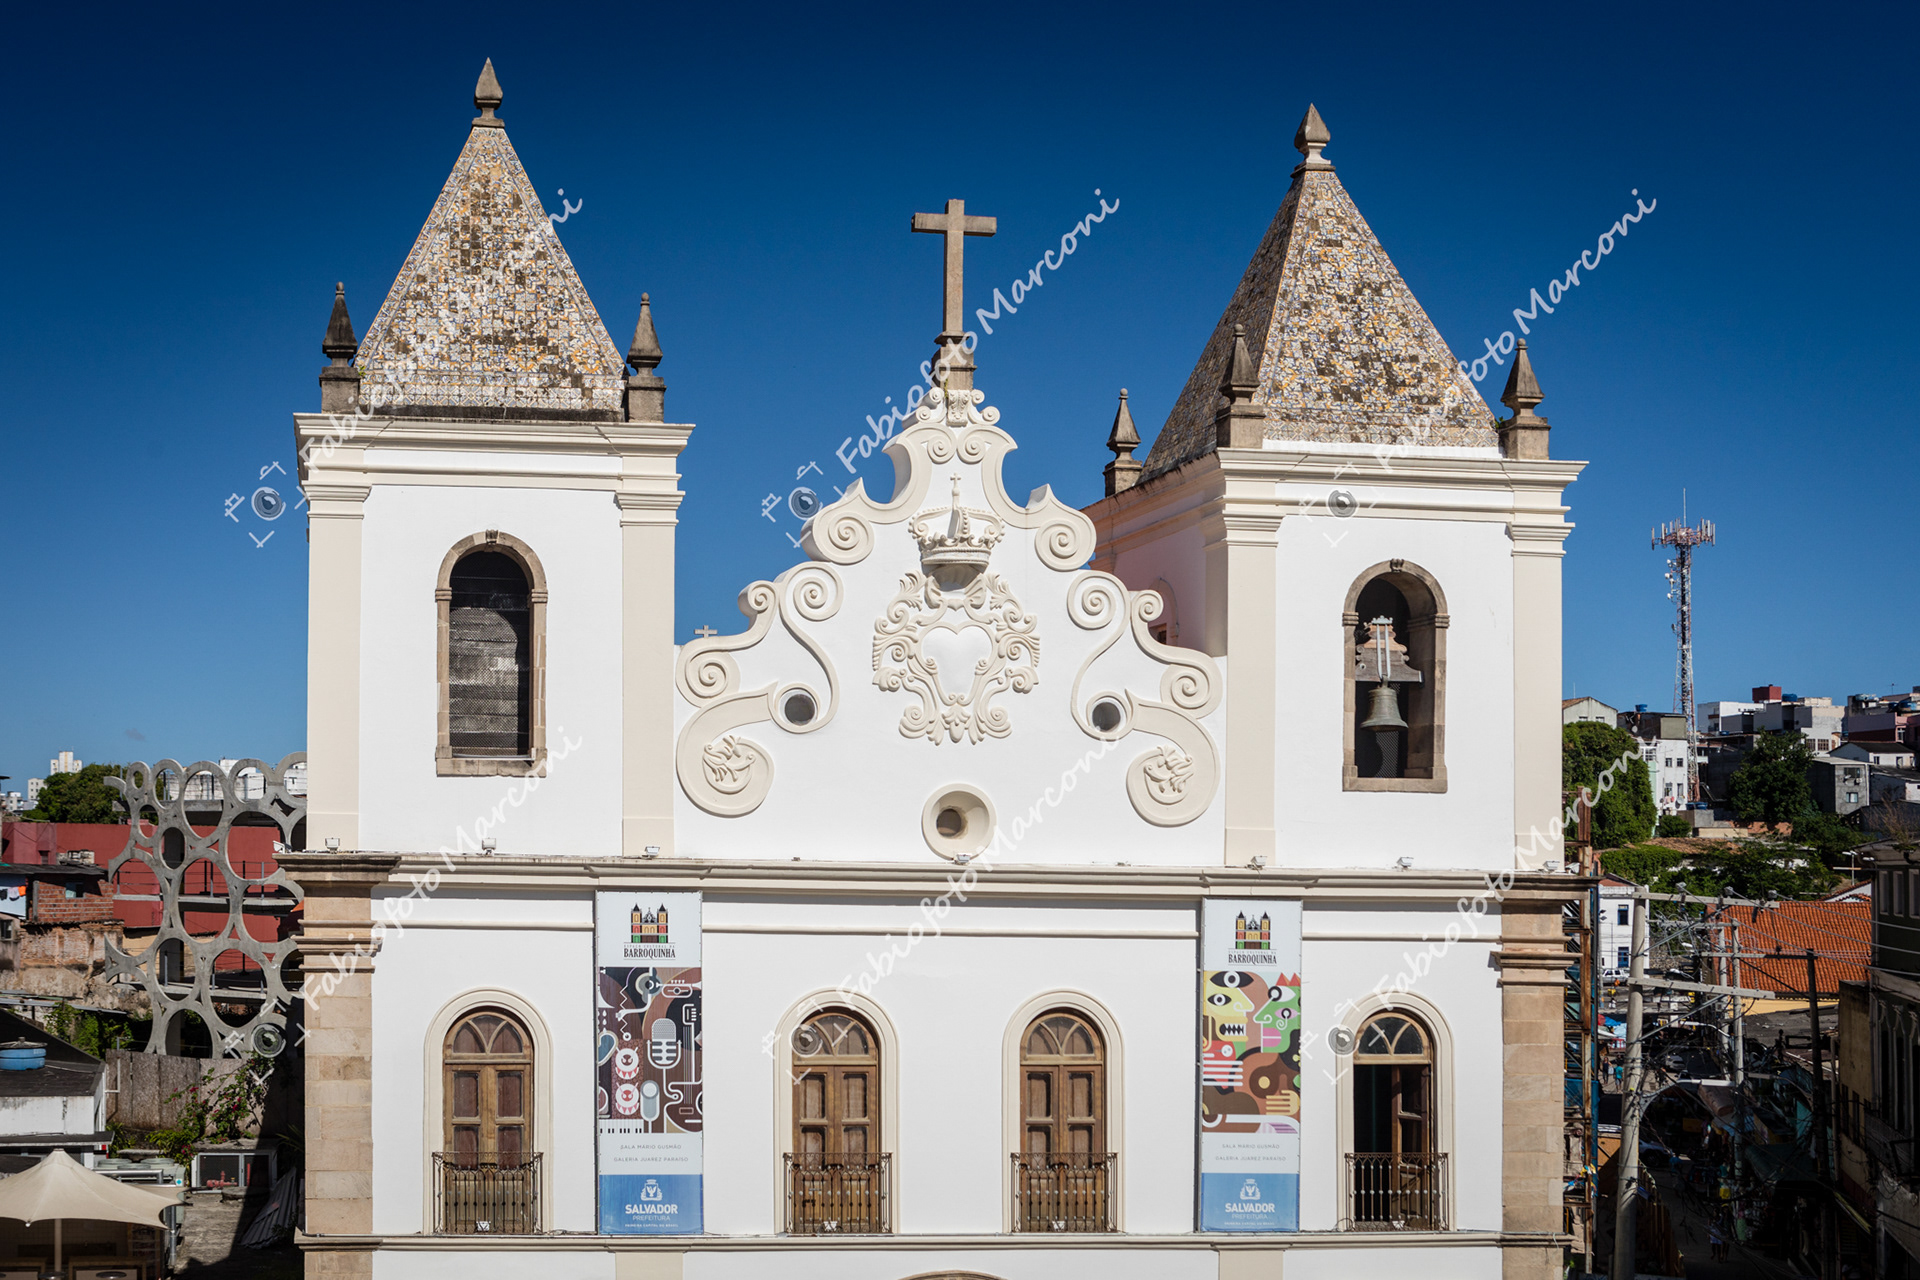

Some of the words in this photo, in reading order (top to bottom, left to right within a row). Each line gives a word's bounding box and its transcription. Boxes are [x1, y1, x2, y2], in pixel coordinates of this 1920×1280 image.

[623, 948, 676, 959] BARROQUINHA
[1228, 954, 1277, 965] BARROQUINHA
[625, 1204, 679, 1214] SALVADOR
[1225, 1202, 1276, 1213] SALVADOR
